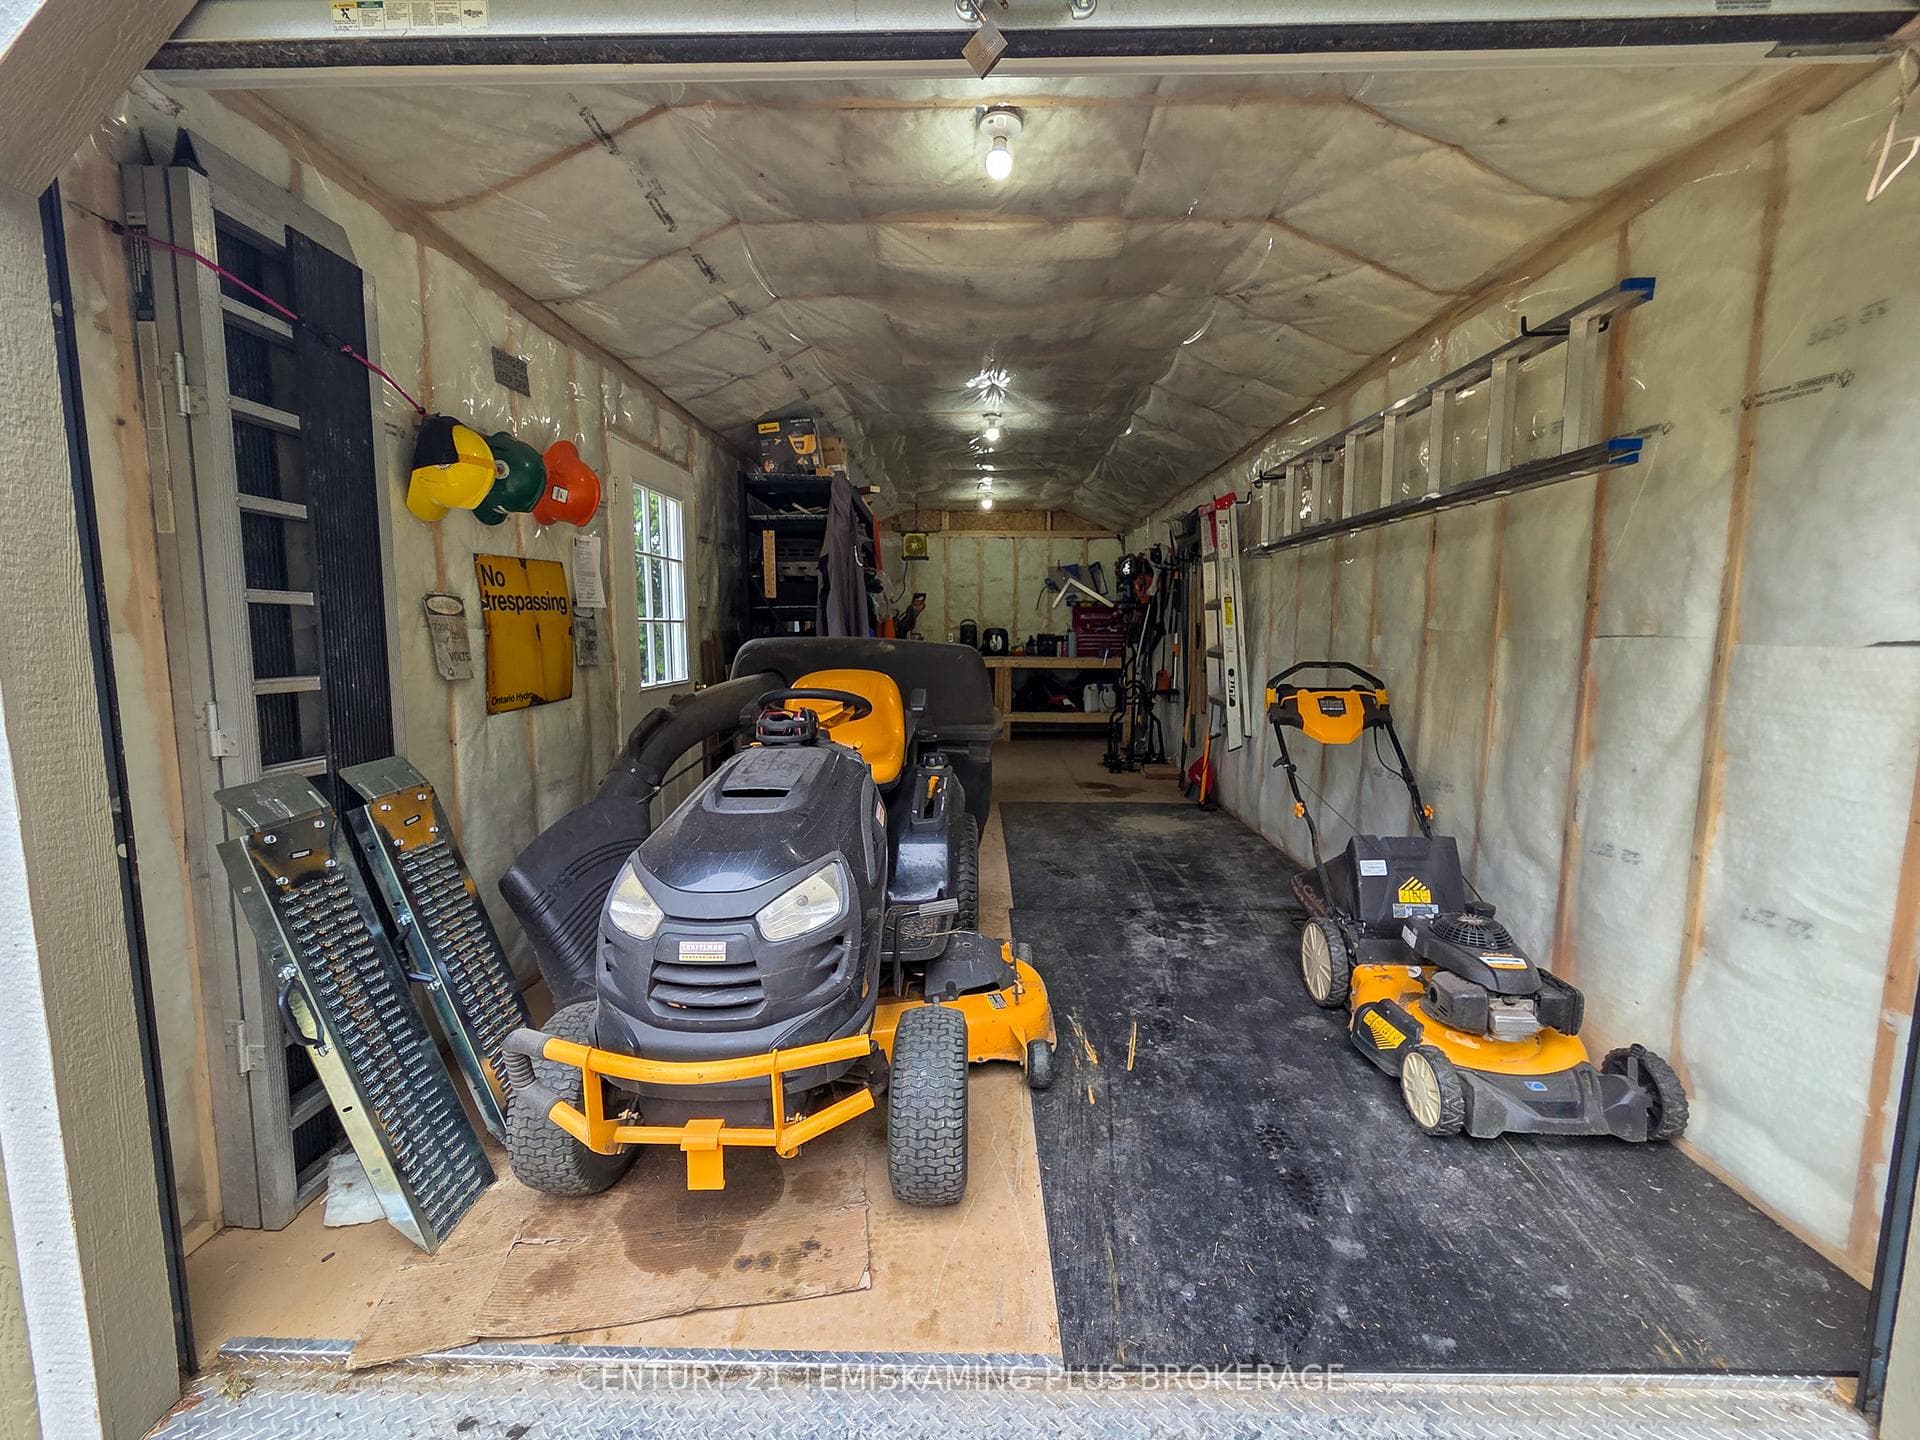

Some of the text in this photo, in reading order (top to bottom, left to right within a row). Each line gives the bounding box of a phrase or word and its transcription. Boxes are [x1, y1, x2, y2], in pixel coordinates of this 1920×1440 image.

[480, 564, 505, 587] No
[484, 590, 567, 615] trespassing
[492, 695, 515, 705] Ontario
